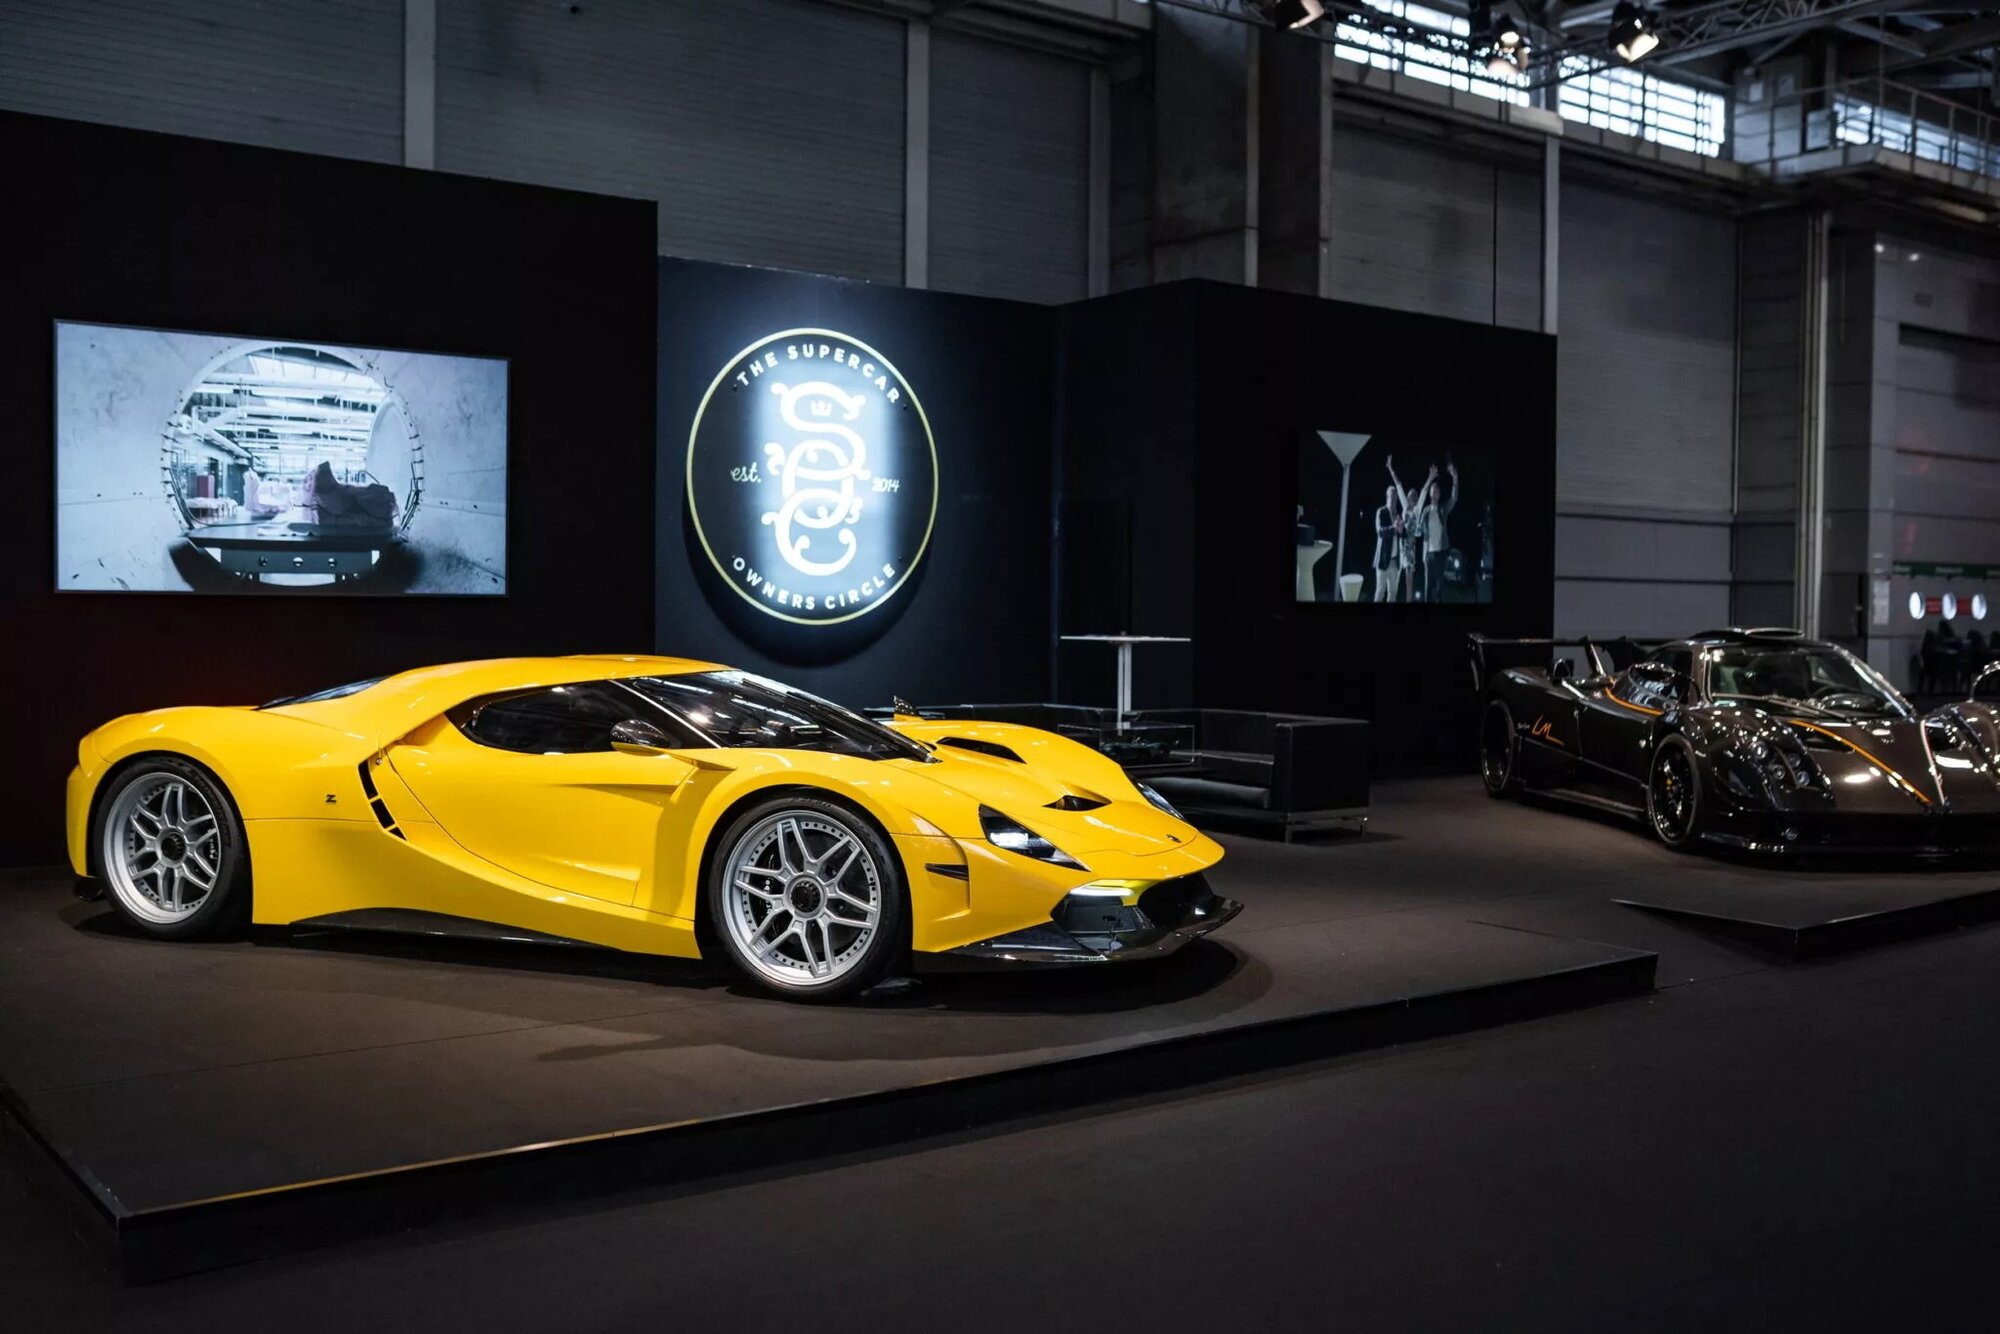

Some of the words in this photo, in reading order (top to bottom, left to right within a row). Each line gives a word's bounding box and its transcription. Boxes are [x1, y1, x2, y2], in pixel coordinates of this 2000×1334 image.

[736, 352, 779, 387] THE
[787, 343, 900, 403] SUPERCAR
[730, 461, 761, 483] est.
[871, 478, 900, 493] 2014
[733, 557, 816, 610] OWNERS
[824, 563, 896, 610] CIRCLE
